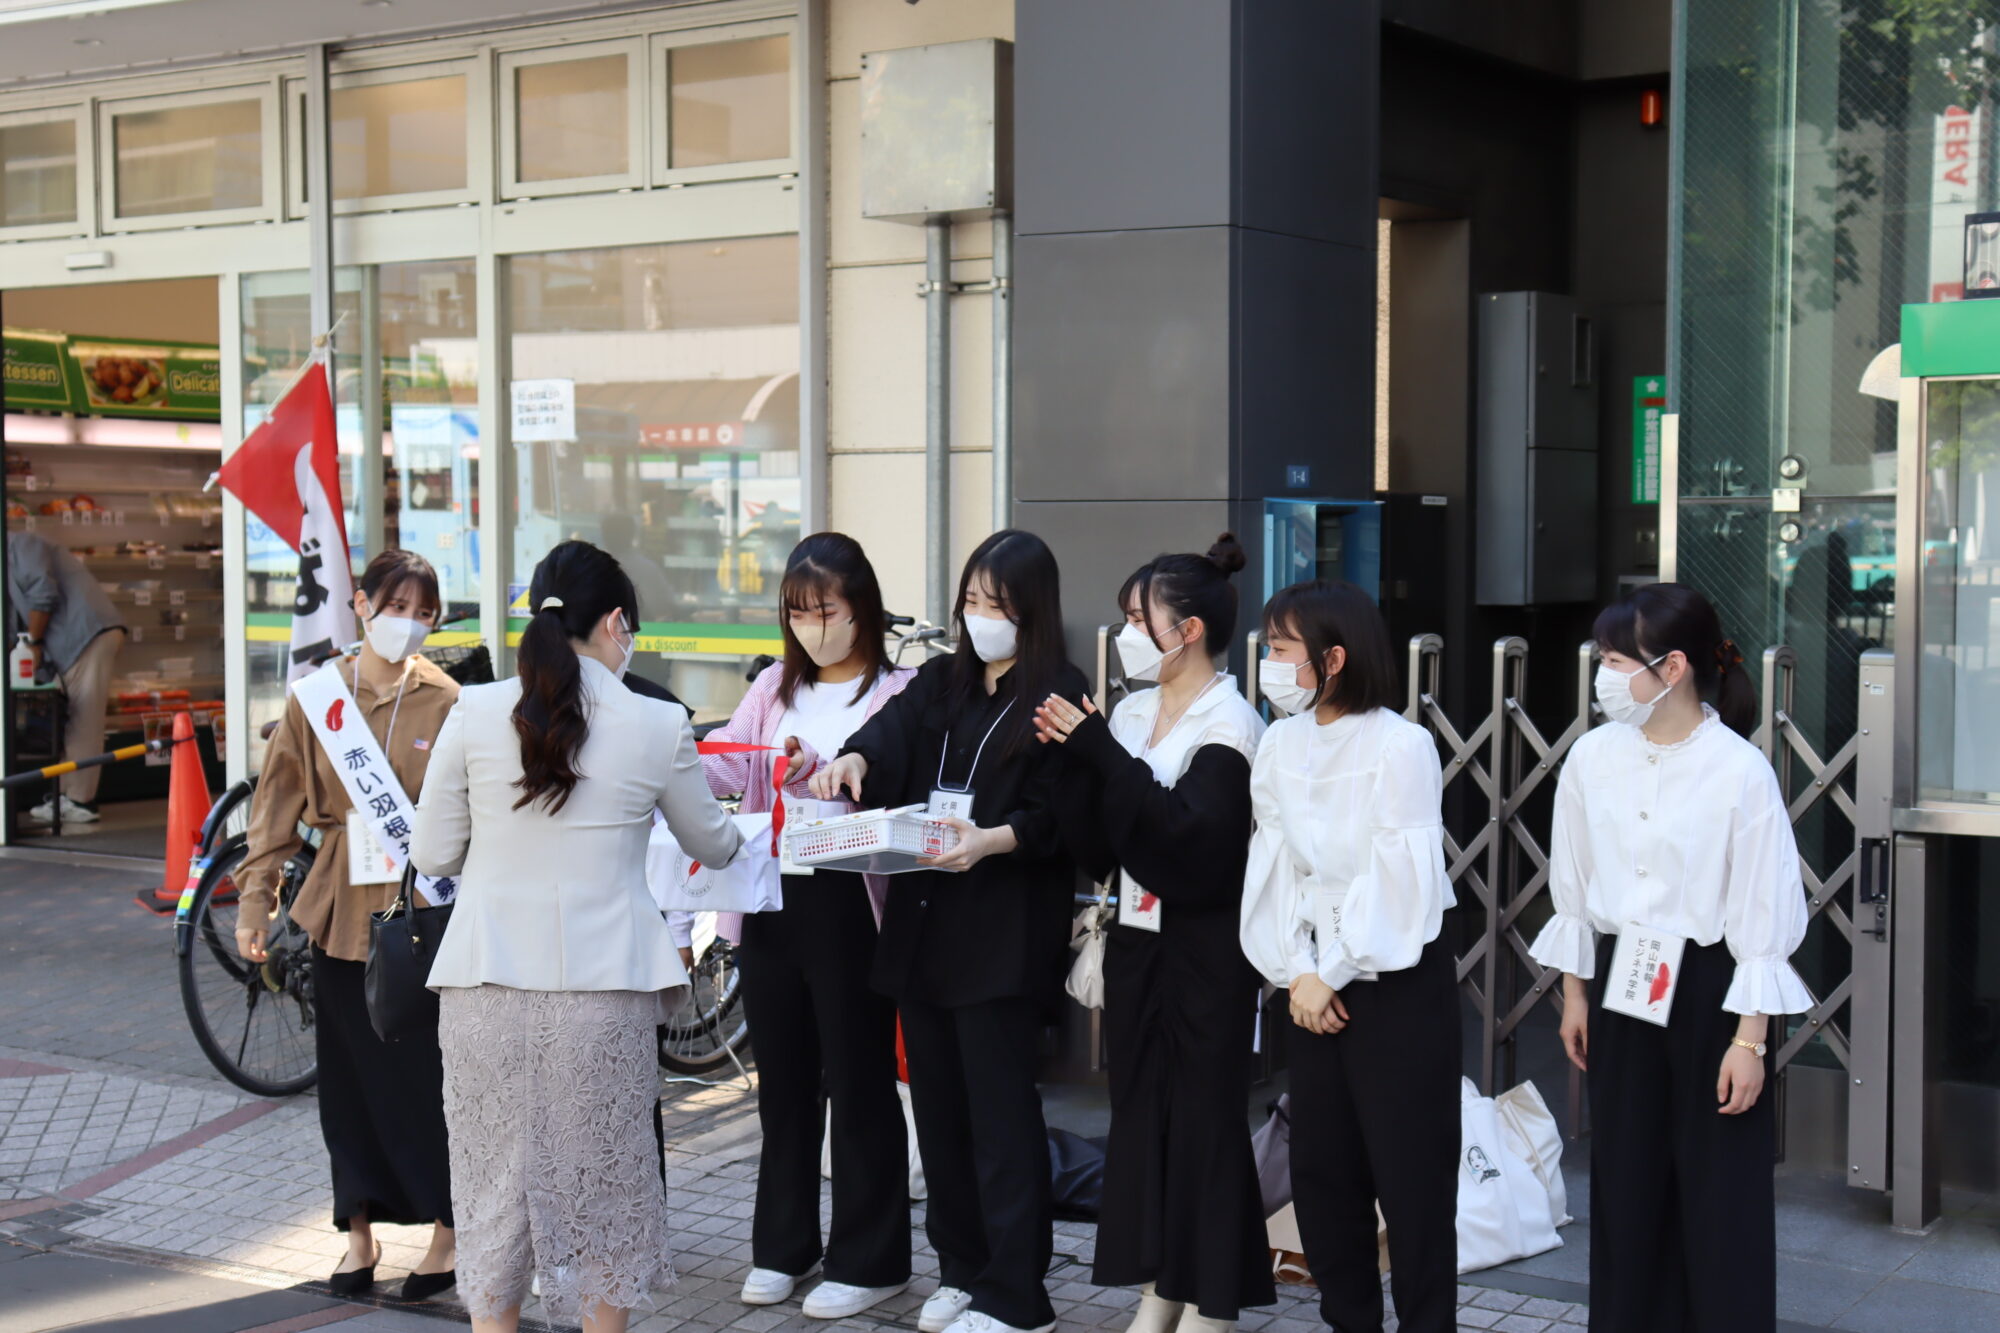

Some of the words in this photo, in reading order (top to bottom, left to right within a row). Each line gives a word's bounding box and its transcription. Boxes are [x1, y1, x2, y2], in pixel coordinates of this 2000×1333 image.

[4, 363, 57, 382] tessen
[1292, 471, 1305, 484] 1-4
[655, 638, 697, 651] discount
[1332, 905, 1342, 939] ビジネ
[1624, 937, 1648, 1001] ビジネス学院
[1643, 939, 1662, 984] 岡山情報
